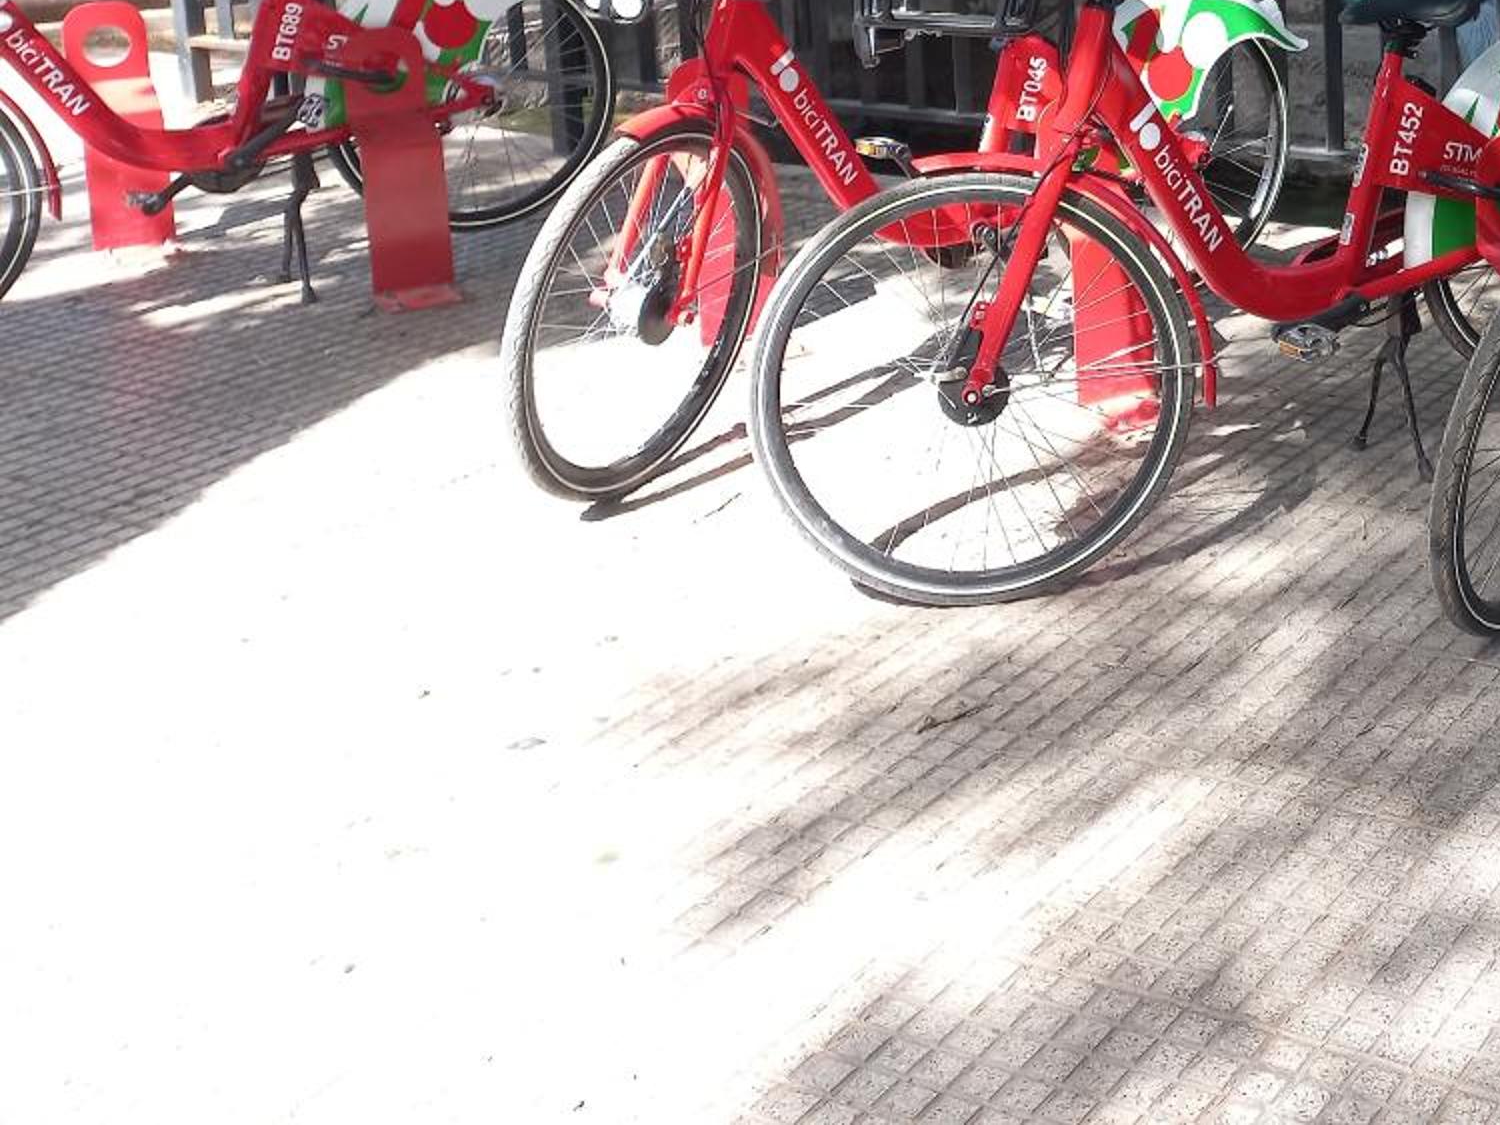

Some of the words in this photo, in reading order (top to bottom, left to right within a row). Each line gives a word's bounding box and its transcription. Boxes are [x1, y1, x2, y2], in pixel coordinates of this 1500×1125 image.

[272, 2, 303, 60] BT689
[5, 28, 91, 116] biciTRAN
[1015, 56, 1047, 123] BT045
[793, 88, 859, 186] biciTRAN
[1389, 102, 1424, 177] BT452
[1154, 143, 1224, 253] biciTRAN
